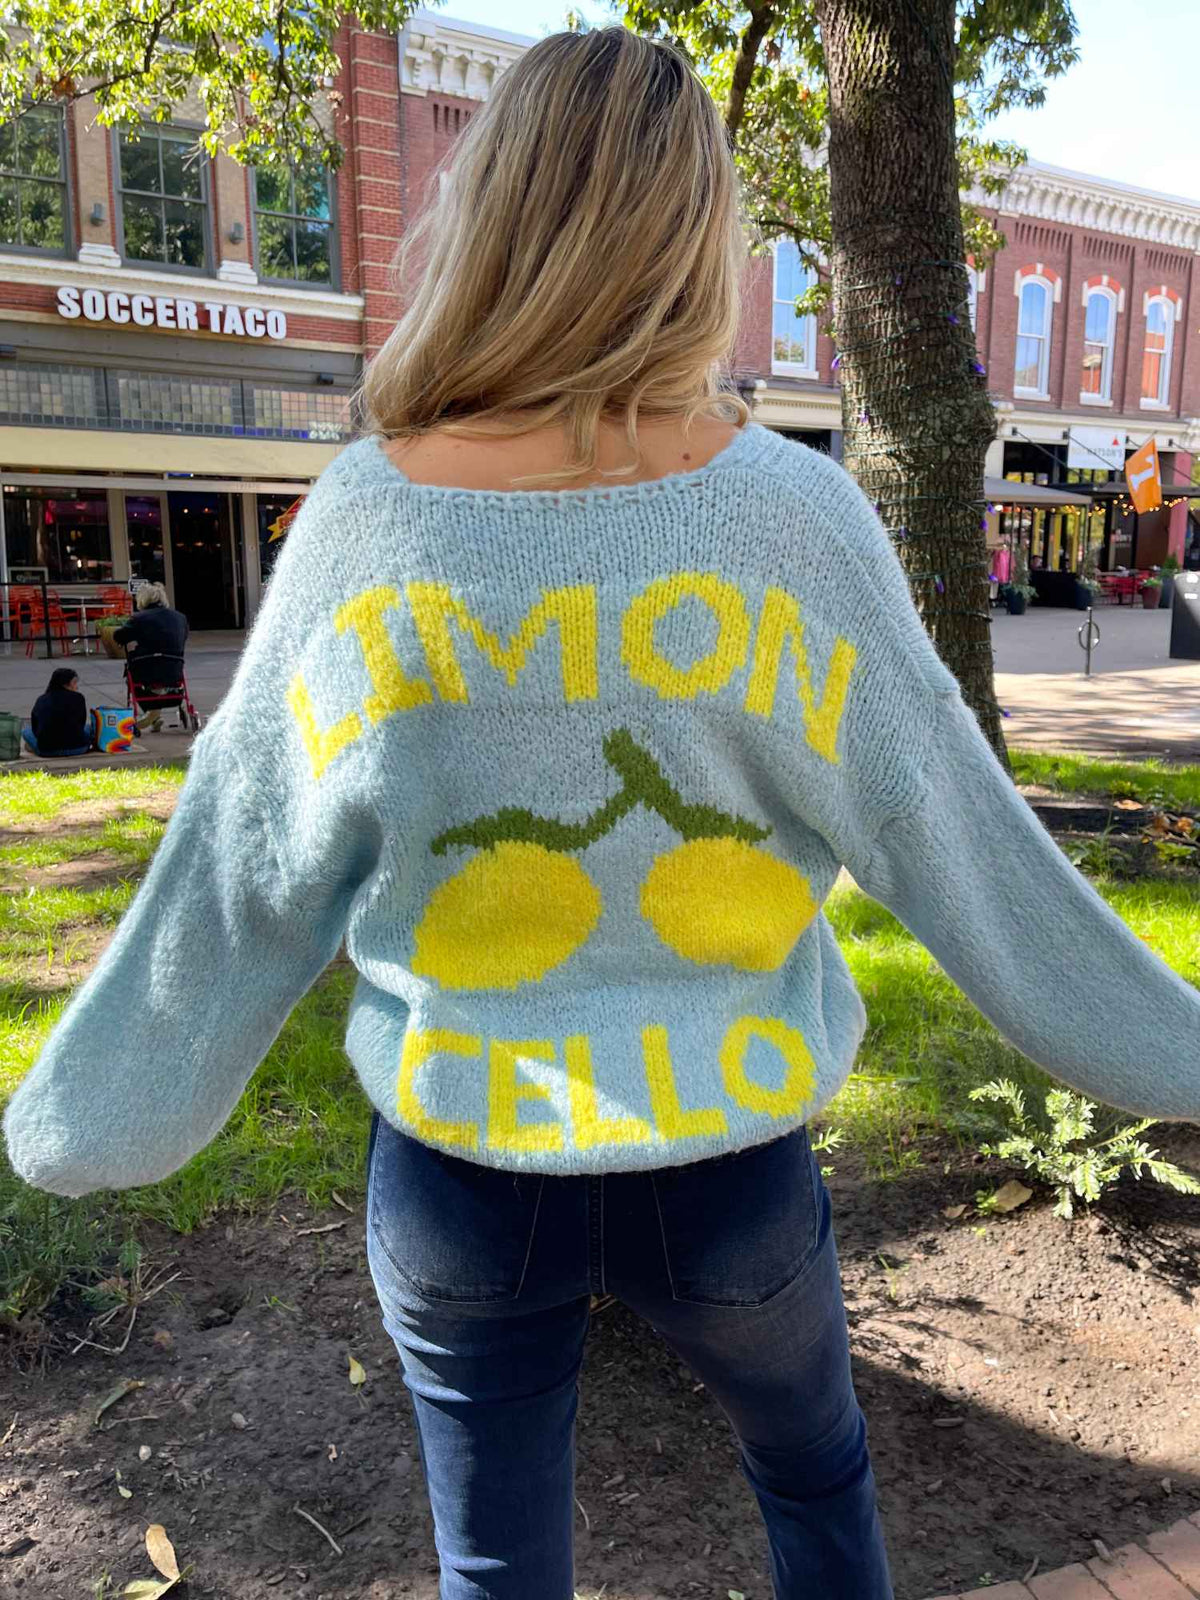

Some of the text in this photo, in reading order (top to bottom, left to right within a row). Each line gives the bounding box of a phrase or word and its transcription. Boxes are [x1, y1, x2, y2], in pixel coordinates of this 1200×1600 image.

[57, 287, 287, 339] SOCCER TACO
[286, 572, 857, 778] LIMON
[397, 1016, 816, 1152] CELLO
